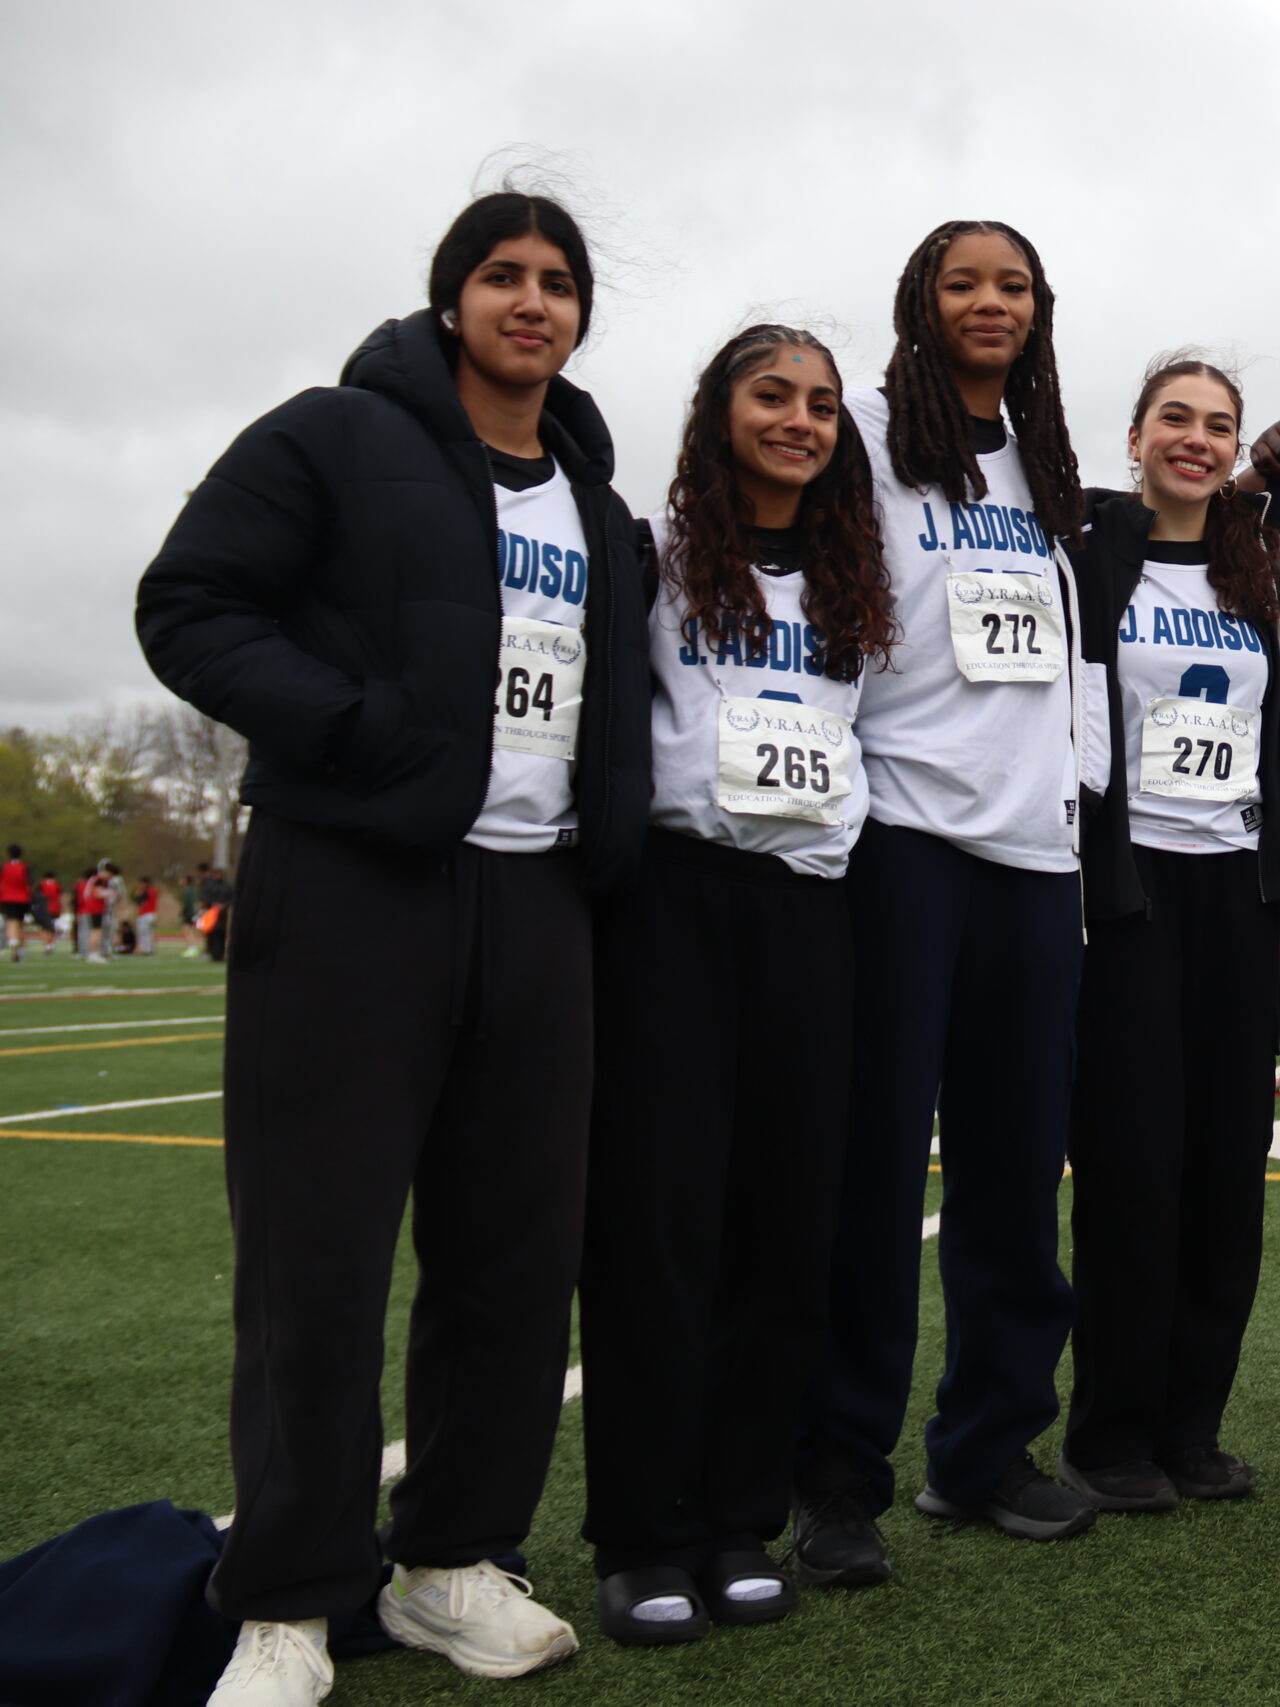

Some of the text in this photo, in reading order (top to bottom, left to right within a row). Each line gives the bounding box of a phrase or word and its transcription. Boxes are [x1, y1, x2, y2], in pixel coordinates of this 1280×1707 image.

[918, 501, 1053, 561] J. ADDISO
[496, 529, 590, 609] DISO
[988, 588, 1036, 601] Y.R.A.A.
[501, 634, 550, 655] .R.A.A.
[981, 613, 1042, 655] 272
[1119, 604, 1146, 643] J.
[679, 612, 858, 690] J. ADDIS
[495, 667, 554, 722] 64
[764, 717, 822, 736] Y.R.A.A.
[1182, 714, 1230, 730] Y.R.A.A.
[756, 743, 830, 794] 265
[1172, 736, 1233, 781] 270
[727, 794, 784, 803] EDUCATION
